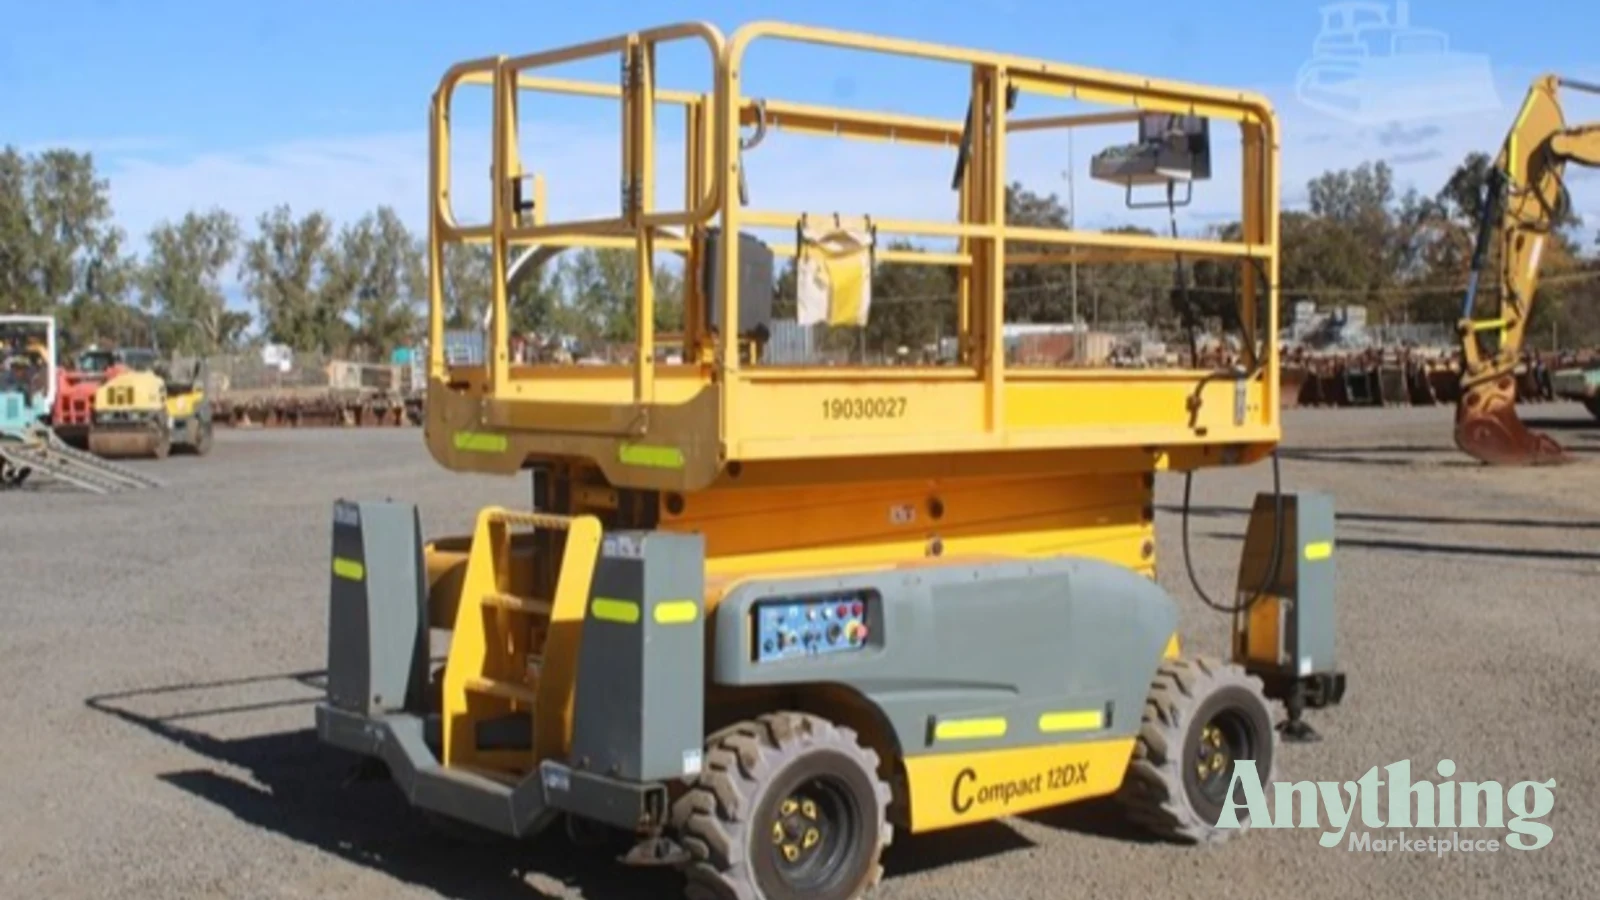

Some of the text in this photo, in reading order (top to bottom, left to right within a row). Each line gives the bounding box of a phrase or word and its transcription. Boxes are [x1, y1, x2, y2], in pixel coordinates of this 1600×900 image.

[822, 397, 907, 419] 19030027
[951, 760, 1090, 815] Compact 12DX
